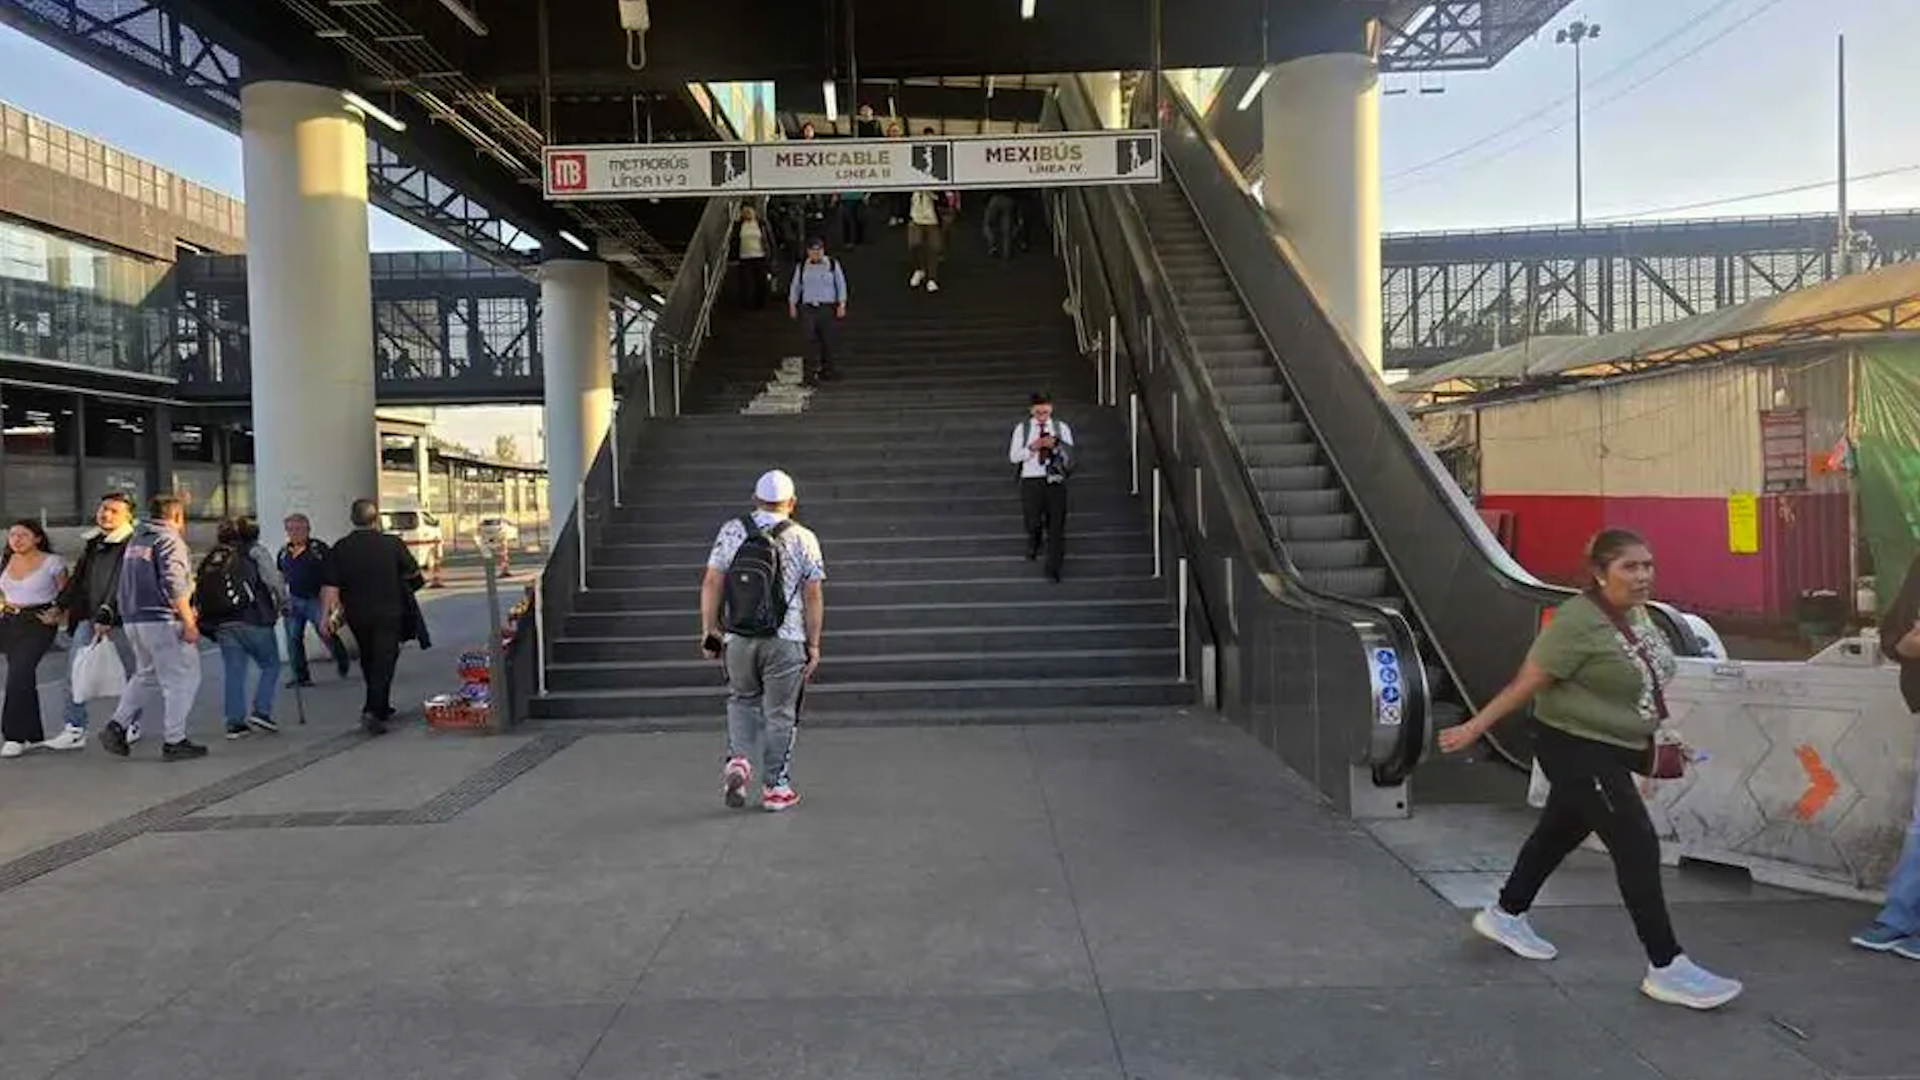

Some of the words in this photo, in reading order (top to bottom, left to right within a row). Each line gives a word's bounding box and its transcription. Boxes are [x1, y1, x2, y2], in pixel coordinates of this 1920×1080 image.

[775, 151, 890, 167] MEXICABLE
[986, 141, 1082, 162] MEXIBÚS
[677, 174, 687, 186] 3
